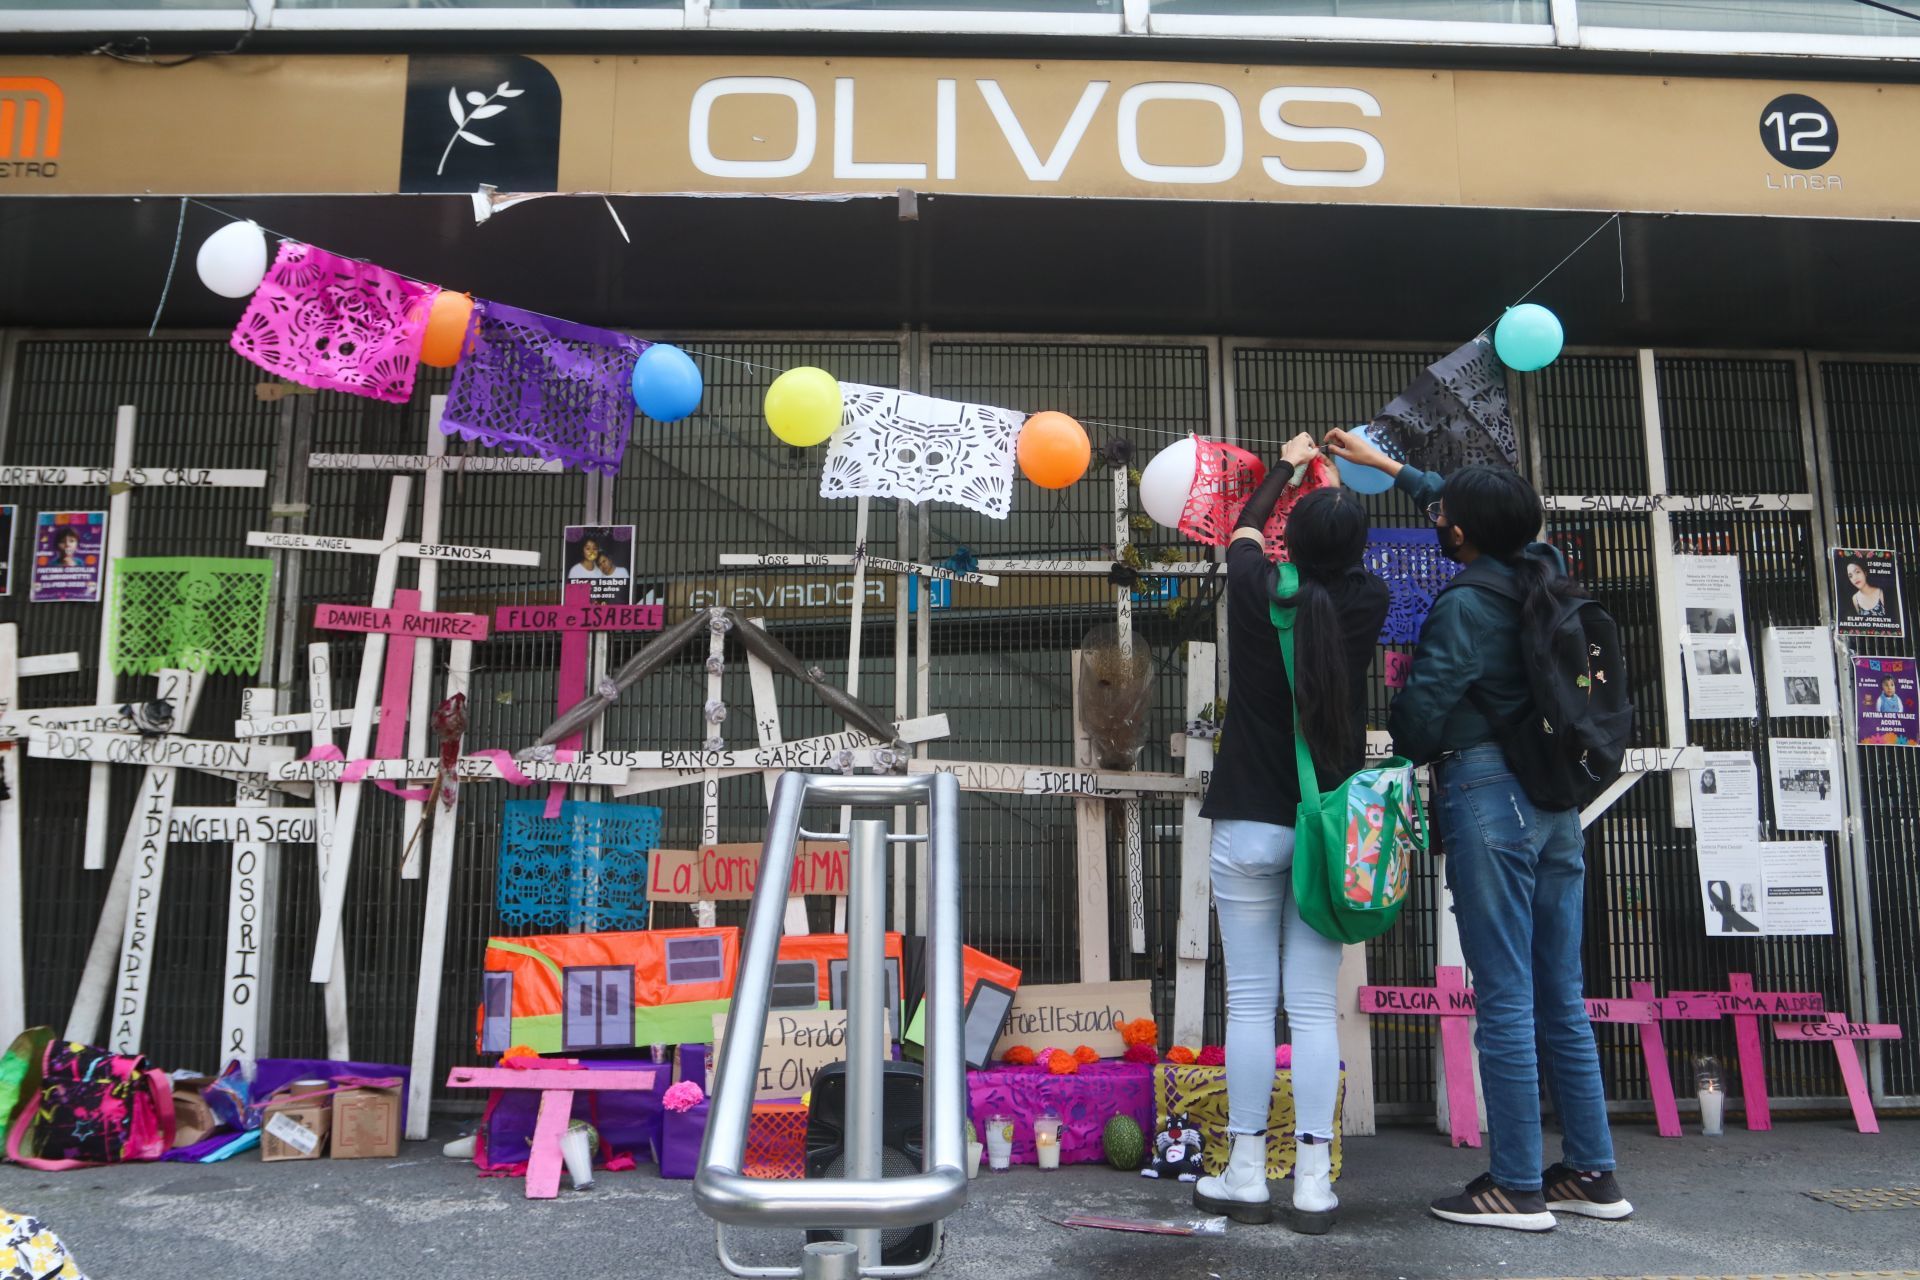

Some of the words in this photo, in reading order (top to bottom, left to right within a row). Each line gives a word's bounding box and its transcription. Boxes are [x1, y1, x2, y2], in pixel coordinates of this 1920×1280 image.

[689, 76, 1385, 187] OLIVOS
[1764, 111, 1831, 153] 12
[1766, 173, 1843, 192] LINEA
[309, 453, 361, 468] SERGIO
[373, 455, 451, 469] VALENTIN
[467, 456, 549, 472] RODRIGUEZ
[162, 470, 213, 486] CRUZ
[1582, 494, 1665, 512] SALAZAR
[1684, 494, 1764, 512] JUAREZ
[265, 534, 309, 548] MIGUEL
[315, 538, 352, 550] ANGEL
[418, 543, 492, 561] ESPINOSA
[758, 554, 789, 566] Jose
[804, 554, 829, 565] Luis
[868, 557, 922, 576] Hernandez
[599, 578, 627, 586] Isabel
[690, 580, 885, 612] ELEVADOR
[328, 610, 392, 629] DANIELA
[402, 612, 472, 635] RAMIREZ
[509, 610, 557, 628] FLOR
[566, 615, 577, 626] e
[580, 606, 658, 628] ISABEL
[27, 715, 131, 733] SANTIAGO
[243, 719, 298, 737] Juan
[45, 730, 93, 760] POR
[106, 738, 250, 767] CORRUPCION
[405, 758, 493, 779] RAMREZ
[515, 760, 592, 783] EDINA
[138, 773, 168, 879] VIDAS
[168, 815, 250, 842] ANGELA
[653, 853, 692, 894] La
[232, 850, 257, 1005] OSORIO
[117, 888, 151, 1054] PERDIDAS
[779, 1015, 847, 1049] Perdó
[1800, 1023, 1871, 1038] CESIAH
